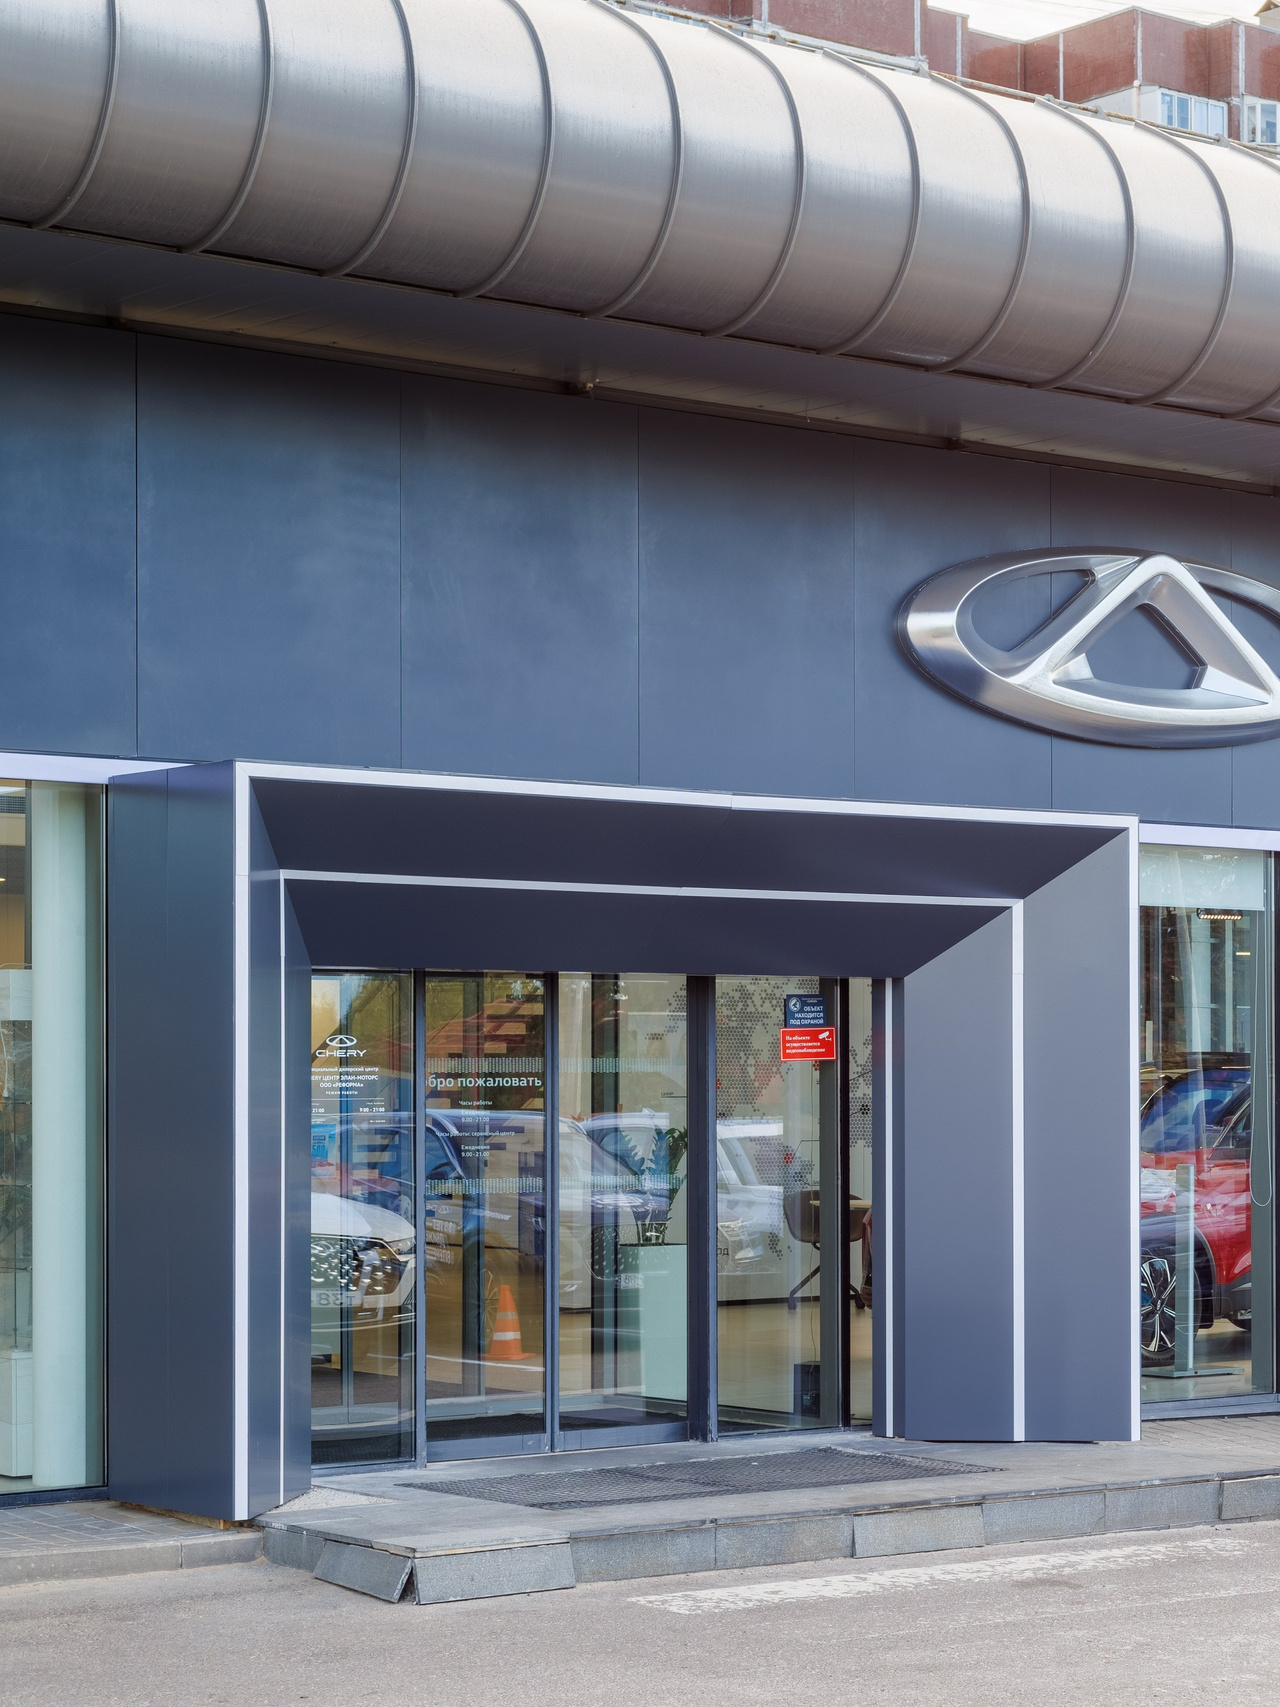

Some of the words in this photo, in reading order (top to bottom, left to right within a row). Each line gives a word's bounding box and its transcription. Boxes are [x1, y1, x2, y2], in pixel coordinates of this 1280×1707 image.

[316, 1049, 366, 1058] CHERY
[426, 1074, 454, 1090] бро
[457, 1077, 542, 1087] пожаловать
